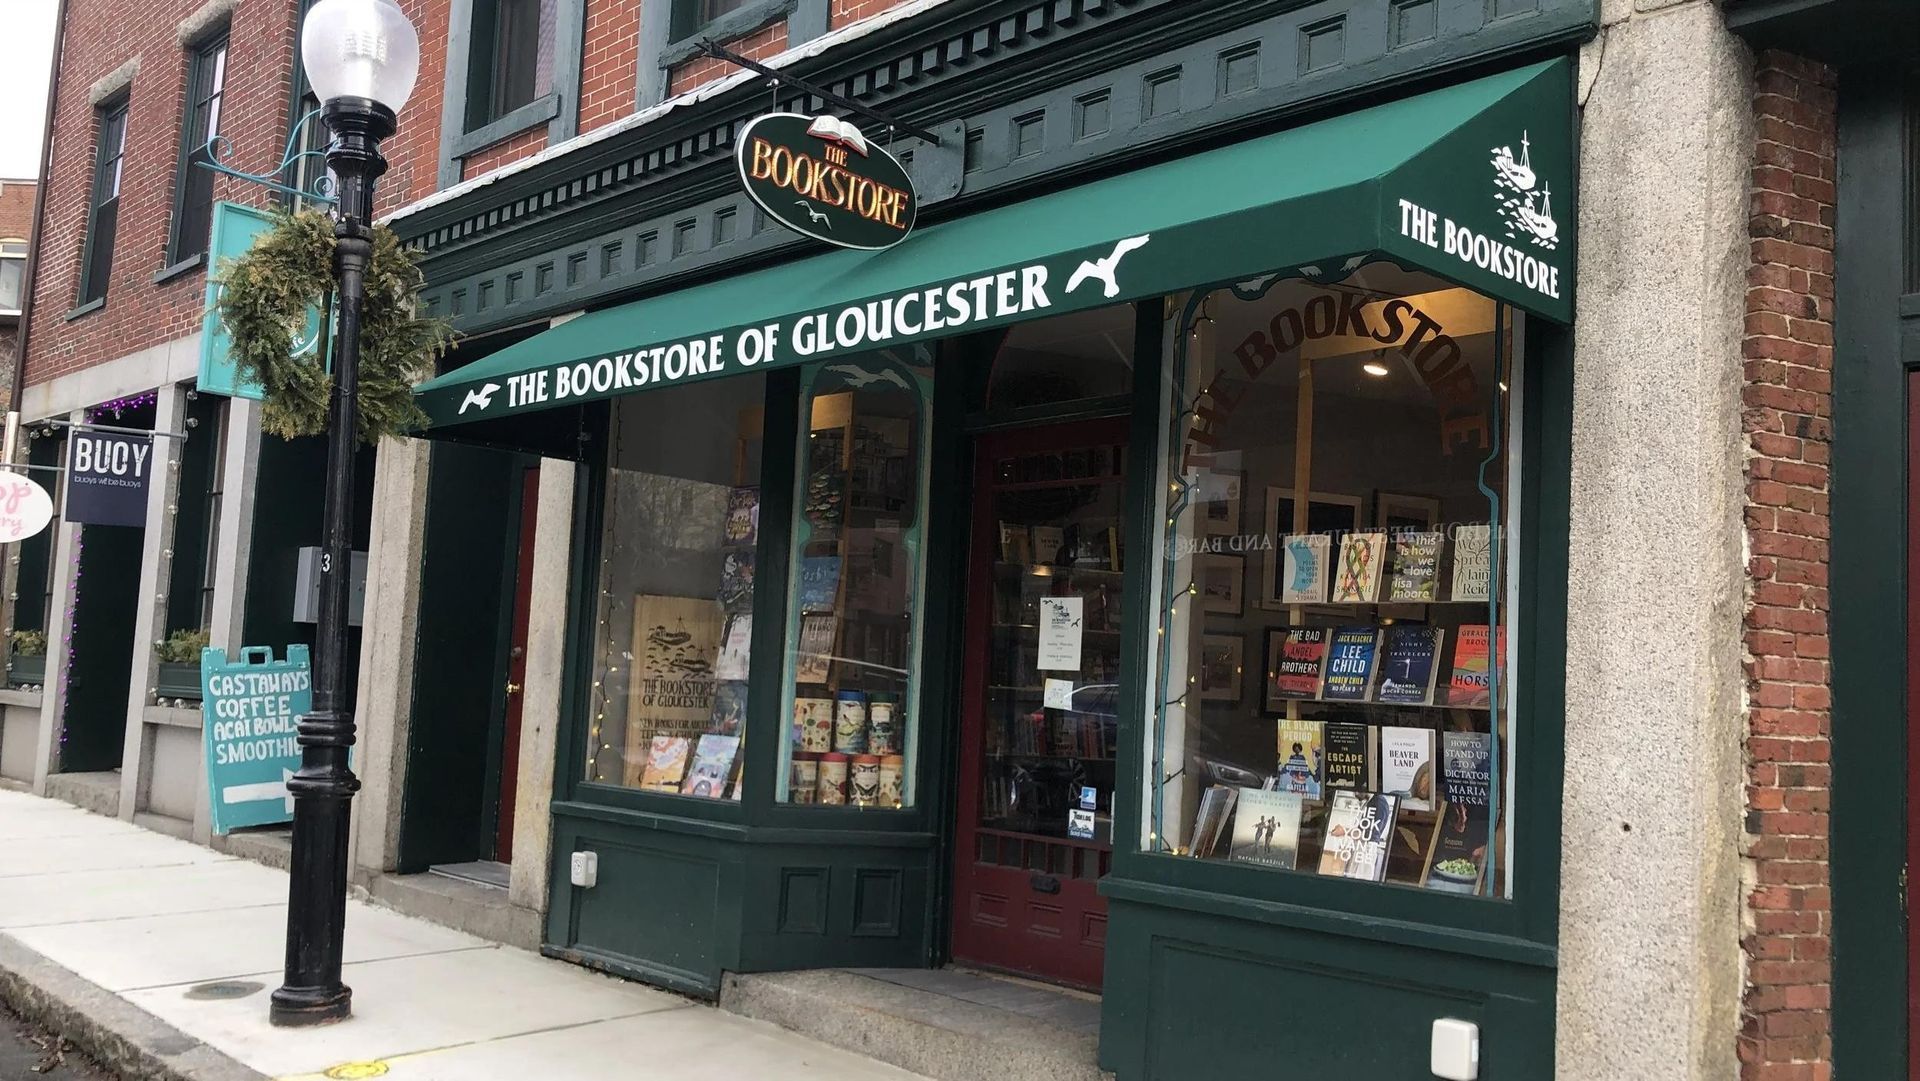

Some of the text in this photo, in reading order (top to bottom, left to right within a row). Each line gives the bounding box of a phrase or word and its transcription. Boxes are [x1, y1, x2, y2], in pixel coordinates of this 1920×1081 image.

[824, 143, 848, 167] THE
[750, 136, 909, 231] BOOKSTORE
[1399, 198, 1560, 300] THE BOOKSTORE
[507, 264, 1053, 408] THE BOOKSTORE OF GLOUCESTER
[1233, 291, 1489, 456] BOOKSTORE
[74, 437, 149, 477] BUOY
[74, 475, 97, 485] buoys
[108, 477, 119, 485] be
[119, 479, 142, 489] buoys
[1416, 535, 1437, 546] this
[1401, 545, 1436, 556] is how
[322, 553, 331, 572] 3
[1418, 558, 1434, 566] we
[1410, 566, 1433, 576] love
[1468, 569, 1490, 580] Iain
[1394, 578, 1412, 589] lisa
[1462, 583, 1490, 595] Reid
[1393, 590, 1430, 599] moore
[1290, 630, 1321, 641] THE BAD
[1291, 647, 1313, 658] ANGEL
[1342, 645, 1363, 659] LEE
[1281, 661, 1318, 674] BROTHERS
[1332, 659, 1366, 673] CHILD
[208, 670, 309, 697] CASTAWAYS
[1328, 676, 1364, 685] ANDREW CHILD
[1455, 675, 1489, 687] HORS
[643, 679, 715, 696] THE BOOKSTORE
[215, 694, 292, 719] COFFEE
[642, 694, 710, 709] OF GLOUCESTER
[213, 714, 304, 742] ACAI BOWLS
[1294, 721, 1320, 732] BLACK
[1283, 731, 1312, 741] PERIOD
[216, 735, 304, 765] SMOOTHIE
[1451, 740, 1482, 749] HOW TO
[1327, 752, 1363, 763] ESCAPE
[1389, 750, 1419, 760] BEAVER
[1445, 750, 1489, 760] STAND UP
[1393, 759, 1414, 768] LAND
[1457, 760, 1468, 769] TO
[1329, 764, 1362, 775] ARTIST
[1445, 769, 1490, 780] DICTATOR
[1448, 785, 1486, 796] MARIA
[1451, 796, 1484, 805] RESSA
[1344, 826, 1373, 841] YOU
[1237, 855, 1260, 863] NATALIE
[1333, 849, 1373, 864] TO BE
